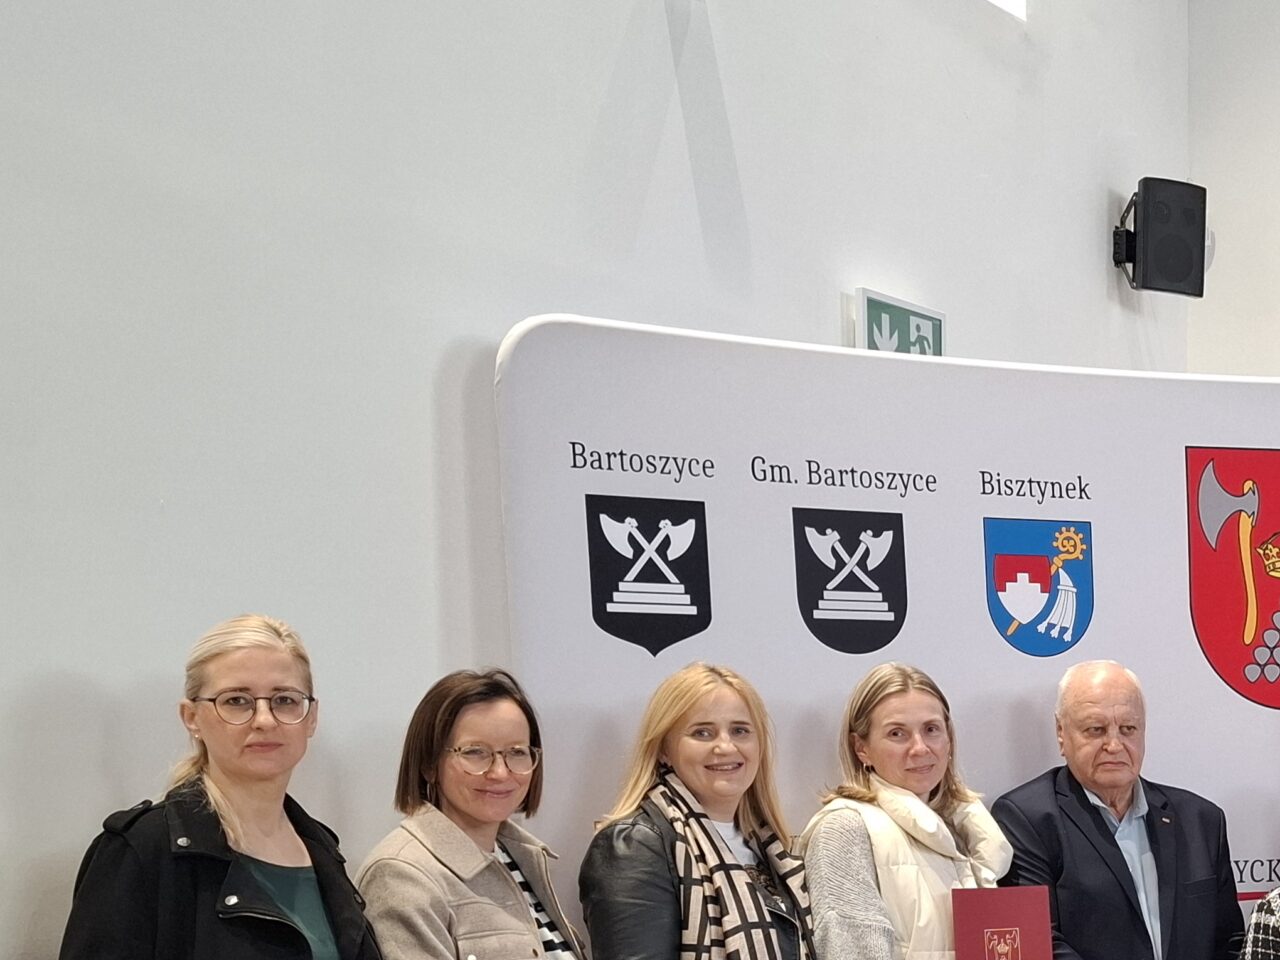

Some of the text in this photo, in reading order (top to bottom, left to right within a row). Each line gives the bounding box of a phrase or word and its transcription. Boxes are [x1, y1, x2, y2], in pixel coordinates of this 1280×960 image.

[568, 441, 715, 484] Bartoszyce
[750, 455, 937, 498] Gm. Bartoszyce
[979, 470, 1092, 505] Bisztynek
